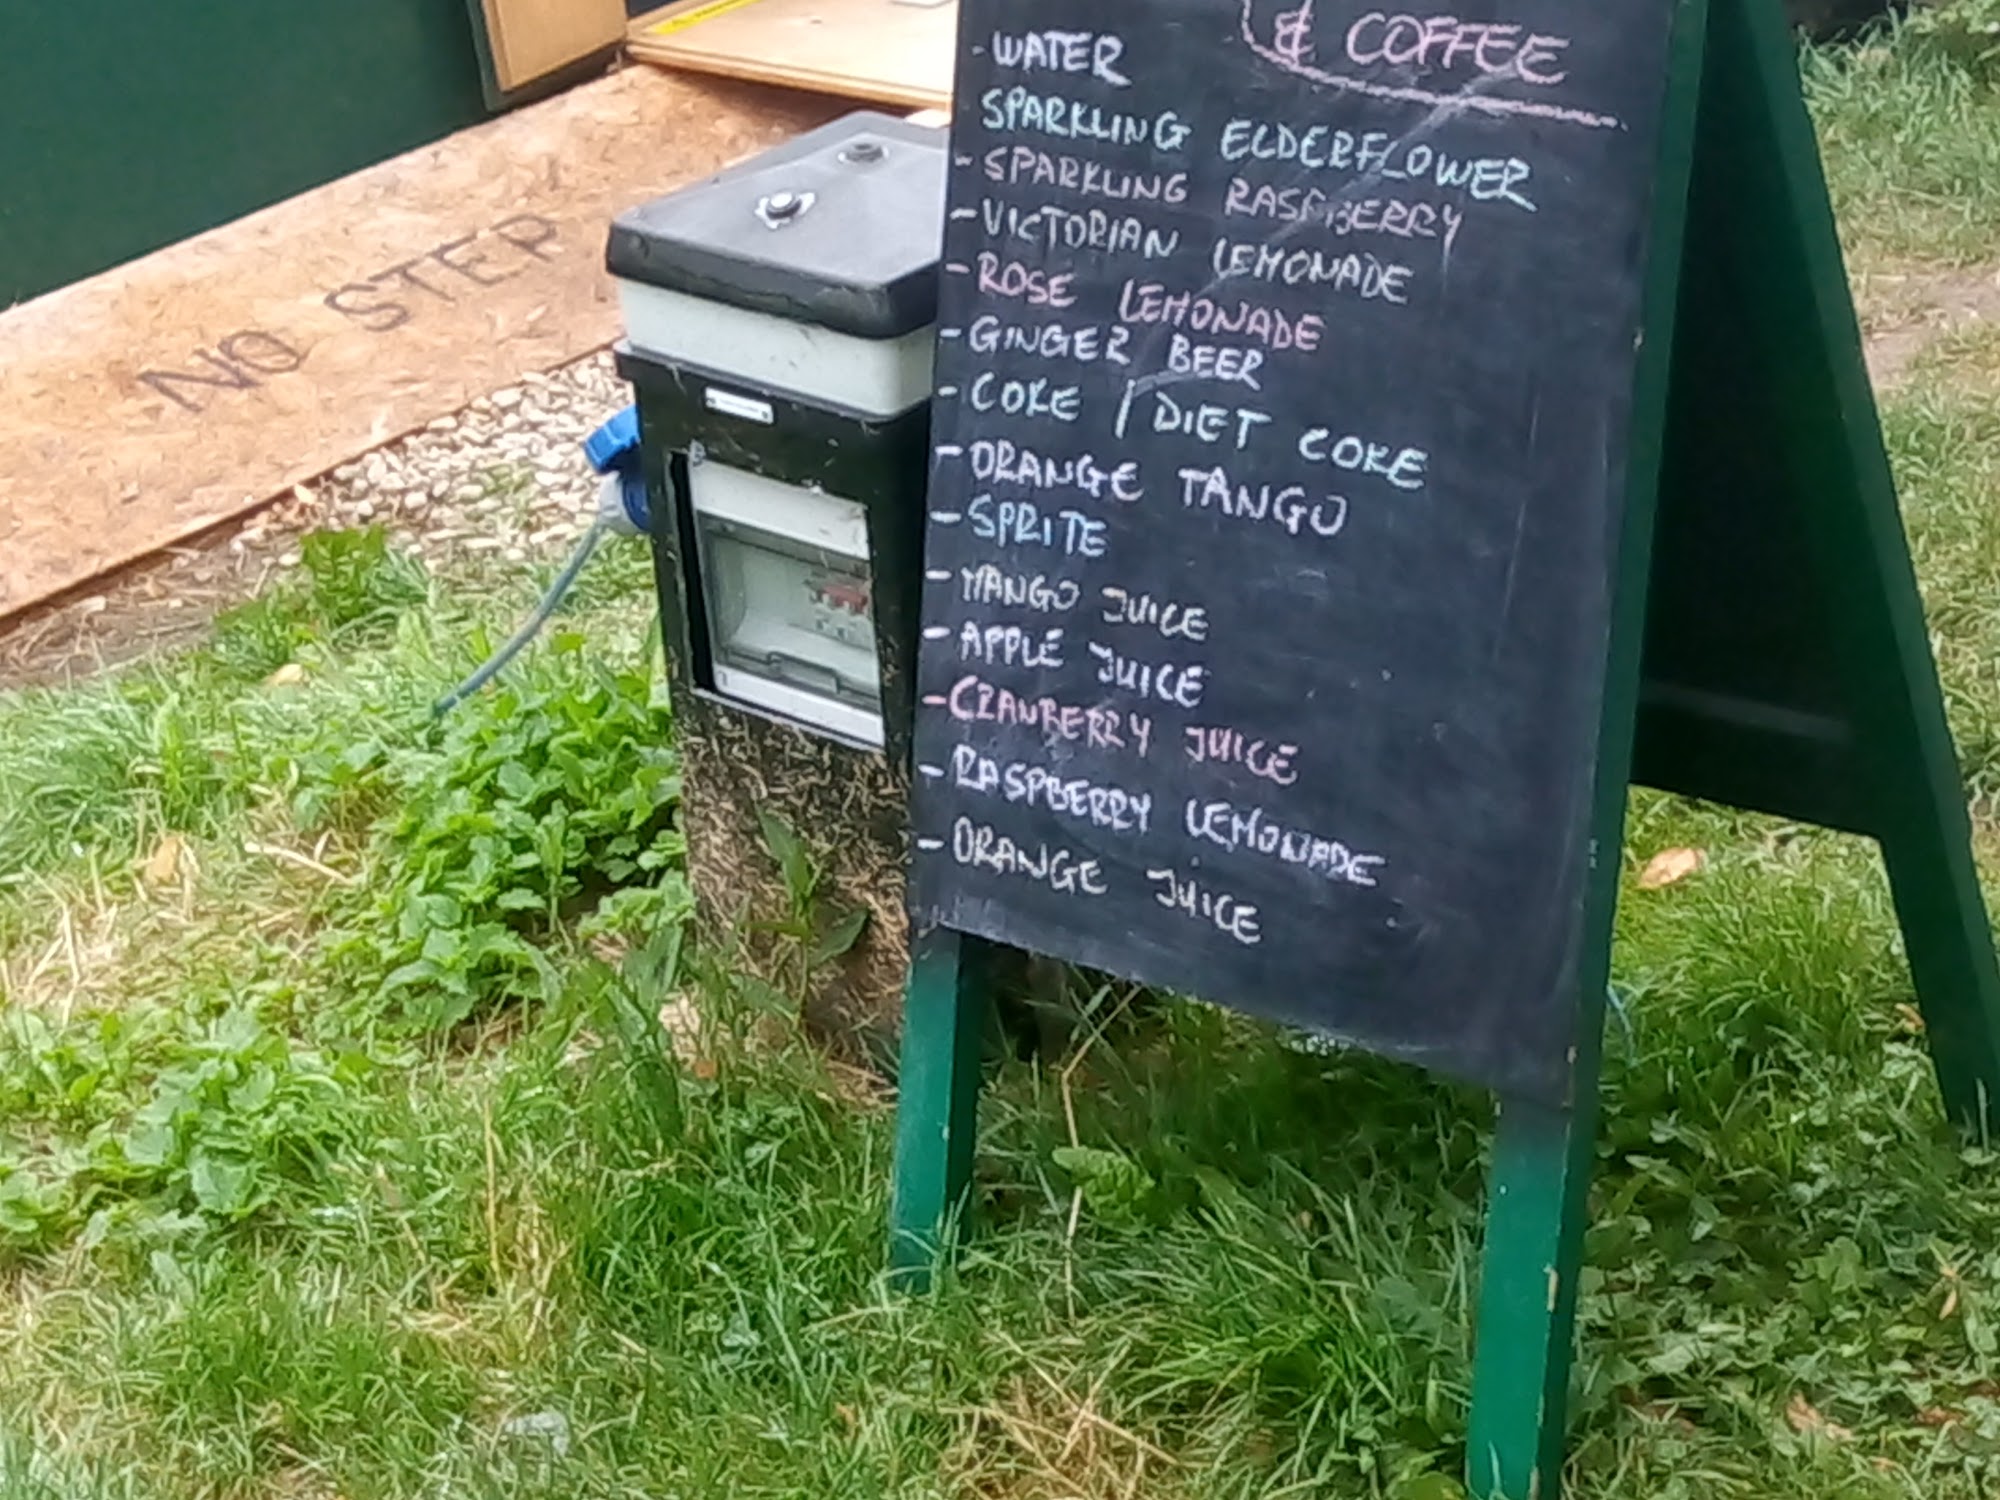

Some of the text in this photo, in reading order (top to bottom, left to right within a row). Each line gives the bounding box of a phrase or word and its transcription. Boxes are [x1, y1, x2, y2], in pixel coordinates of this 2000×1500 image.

[993, 31, 1132, 86] WATER
[1347, 13, 1570, 84] COFFEE
[982, 85, 1537, 212] SPARKLING ELDERFLOWER
[982, 146, 1188, 204] SPARKLING
[976, 251, 1327, 352] ROSE LEMONADE
[982, 201, 1414, 304] VICTORIAN LEMONADE
[138, 213, 558, 412] NO STEP
[968, 317, 1264, 388] GINGER BEER
[971, 372, 1081, 421] COKE
[1298, 427, 1430, 490] COKE
[968, 495, 1108, 557] SPRITE
[969, 439, 1348, 537] ORANGE TANGO
[961, 568, 1210, 641] MANGO JUICE
[960, 621, 1204, 708] APPLE JUICE
[950, 675, 1299, 785] CRANBERRY JUICE
[951, 744, 1386, 887] RASPBERRY LEMONADE
[952, 816, 1262, 945] ORANGE JUICE
